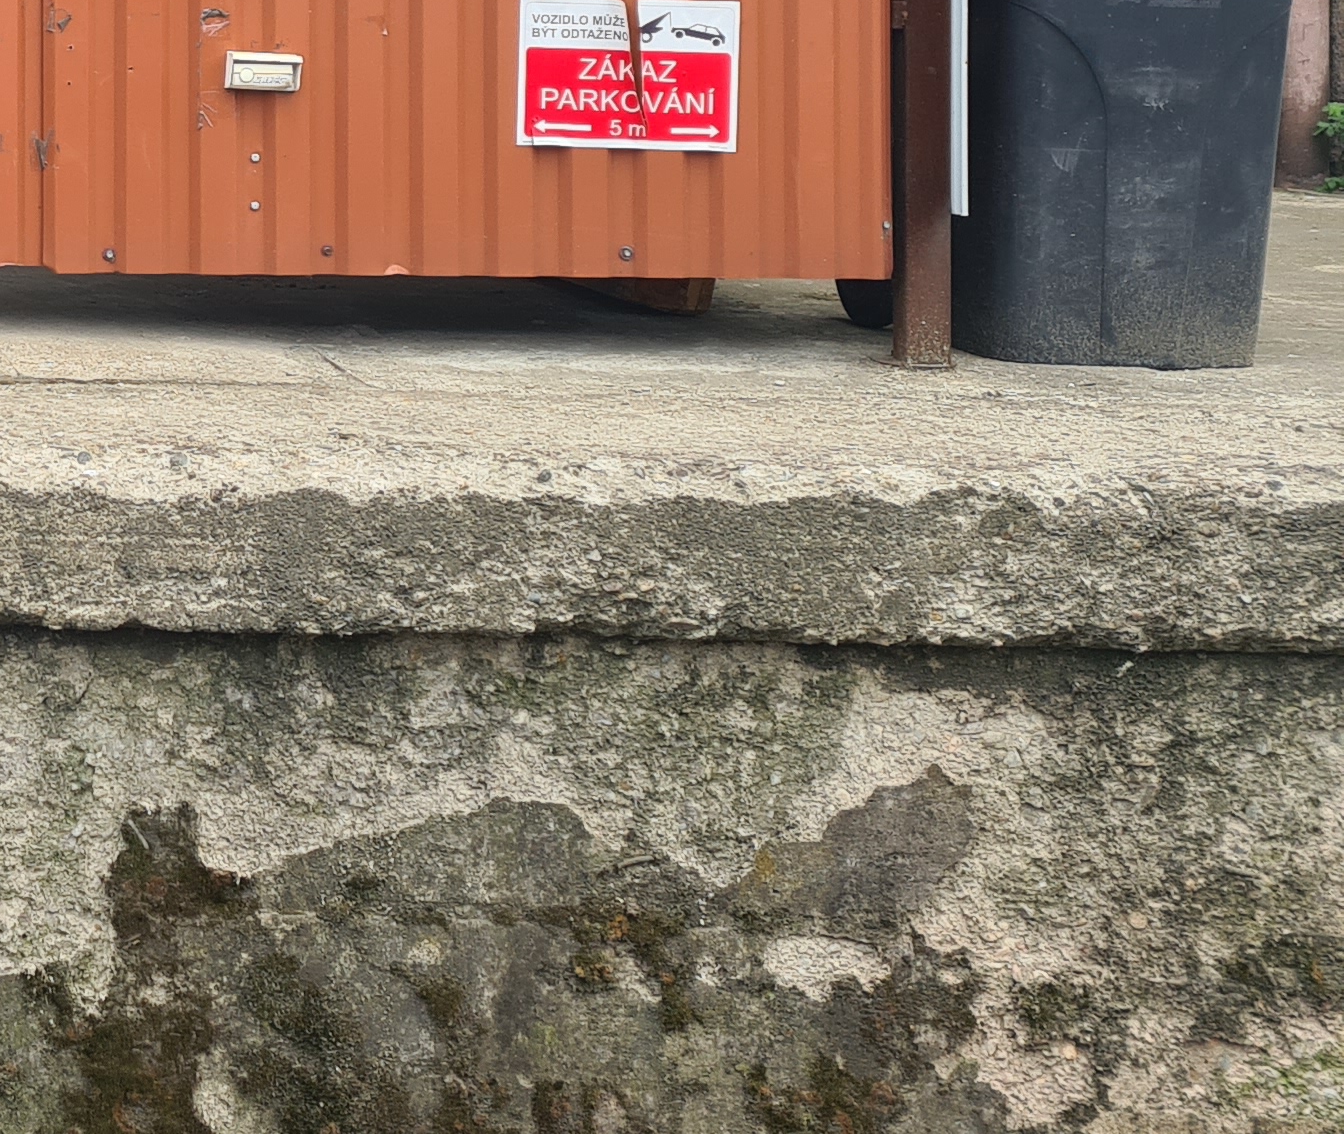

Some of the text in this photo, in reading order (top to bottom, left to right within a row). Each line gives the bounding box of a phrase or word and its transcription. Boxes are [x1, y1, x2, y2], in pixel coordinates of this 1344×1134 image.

[532, 13, 626, 28] VOZIDLO MŮŽE
[532, 25, 557, 39] BÝT
[579, 54, 677, 83] ZÁKAZ
[540, 87, 715, 115] PARKOVÁNÍ
[609, 120, 647, 138] 5 m
